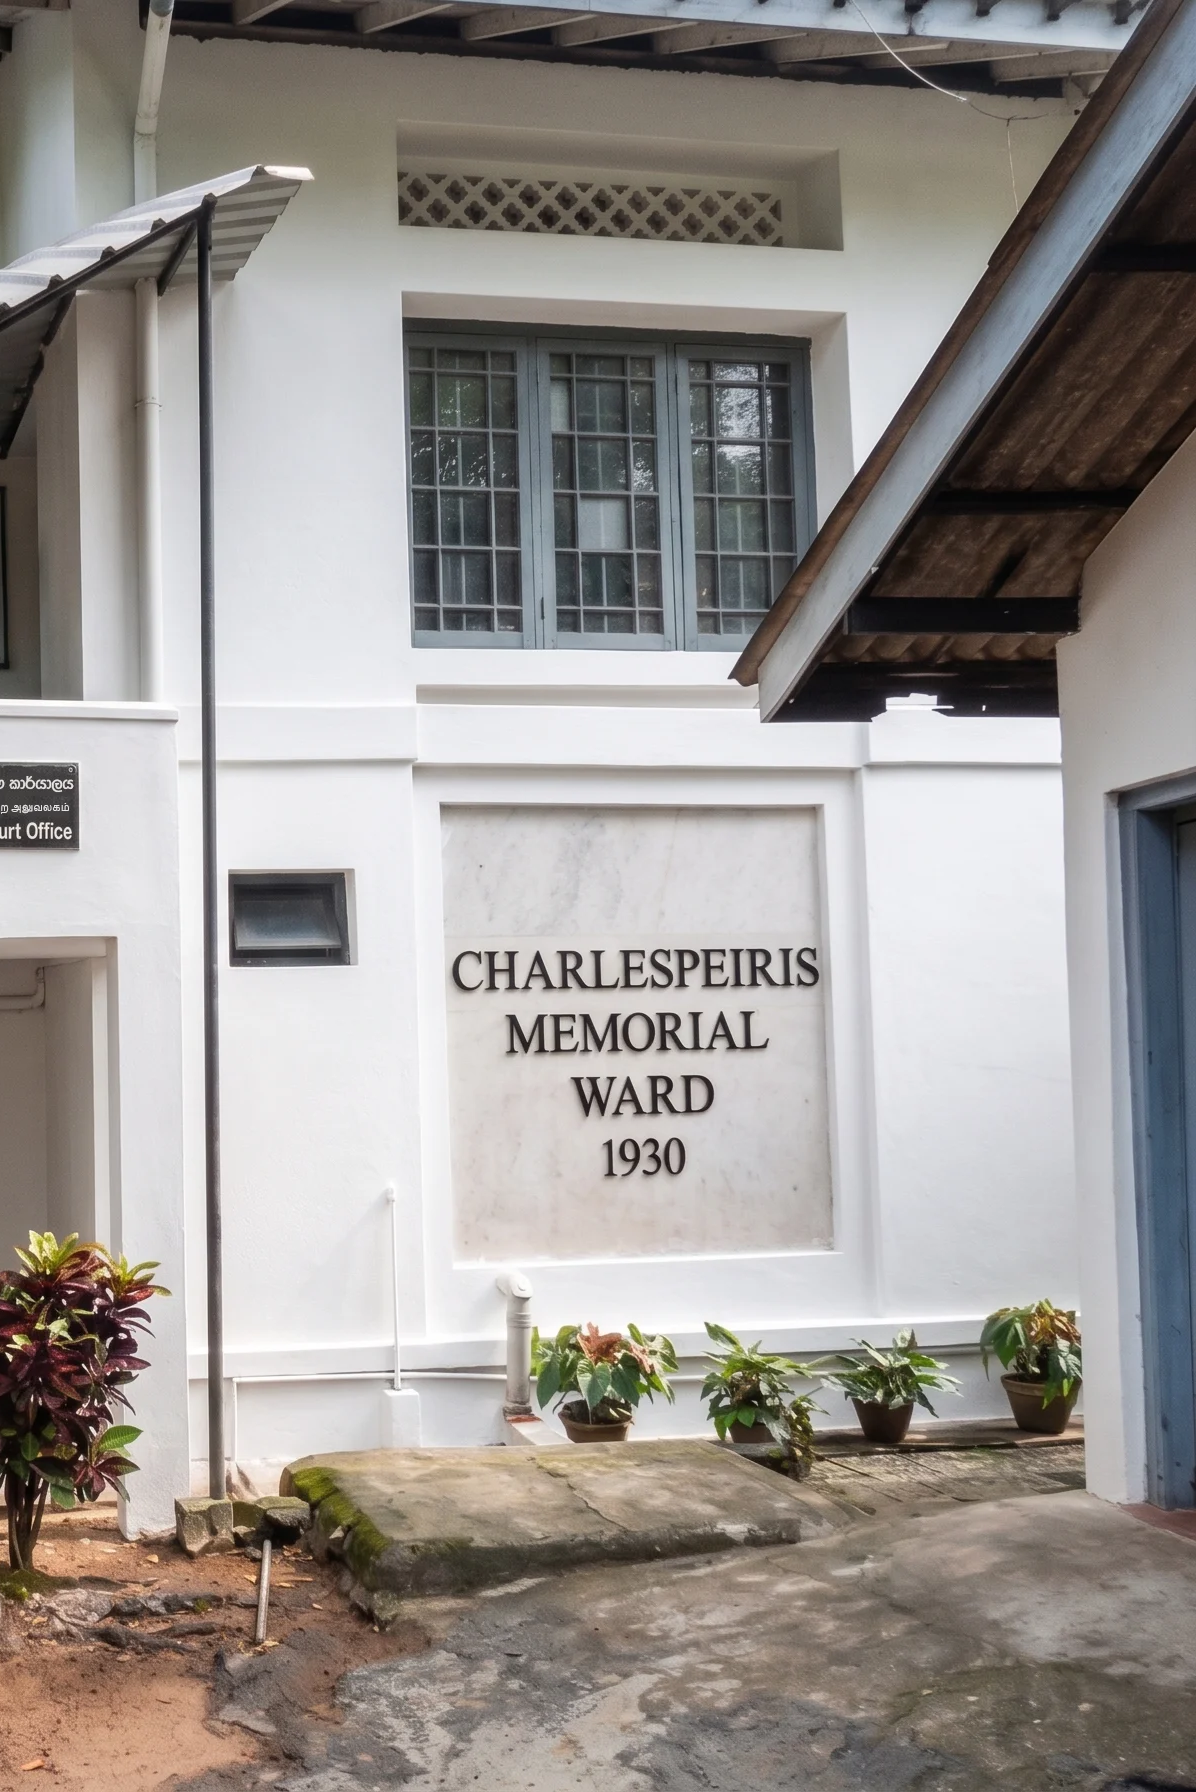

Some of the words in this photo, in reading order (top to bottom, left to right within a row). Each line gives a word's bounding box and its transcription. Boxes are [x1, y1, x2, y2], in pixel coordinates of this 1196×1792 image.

[26, 821, 73, 840] Office
[505, 1010, 770, 1054] MEMORIAL
[570, 1074, 715, 1117] WARD
[601, 1137, 686, 1177] 1930
